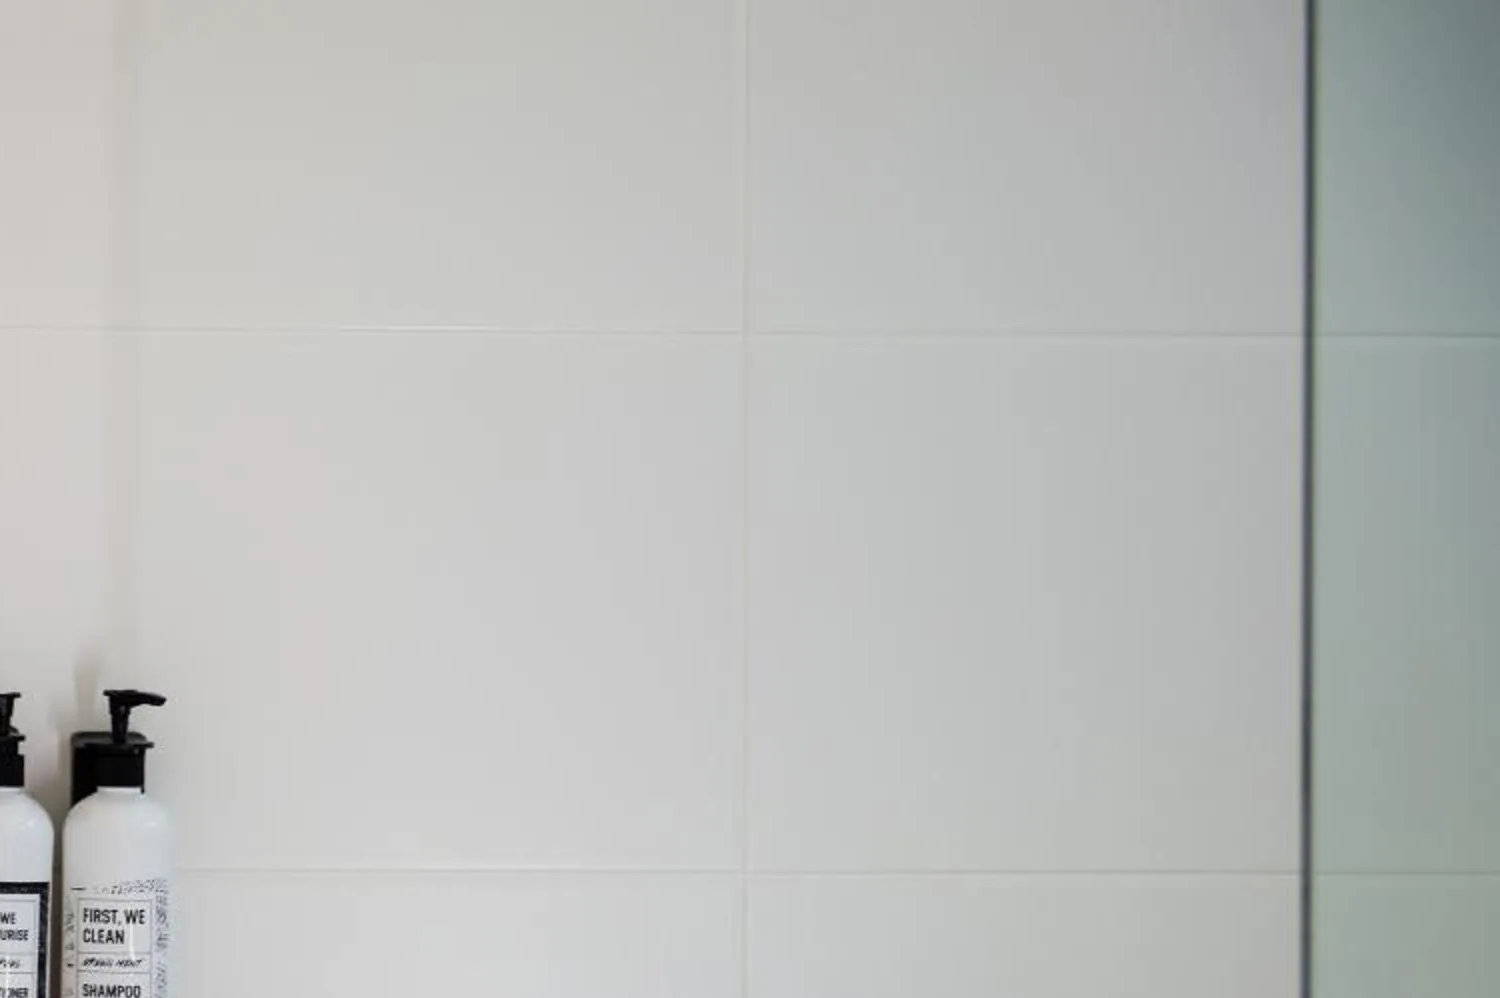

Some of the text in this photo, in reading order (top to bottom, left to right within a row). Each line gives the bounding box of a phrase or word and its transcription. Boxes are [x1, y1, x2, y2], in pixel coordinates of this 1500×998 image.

[0, 912, 18, 925] WE
[82, 908, 146, 926] FIRST, WE
[82, 928, 125, 945] CLEAN
[82, 983, 142, 998] SHAMPOO
